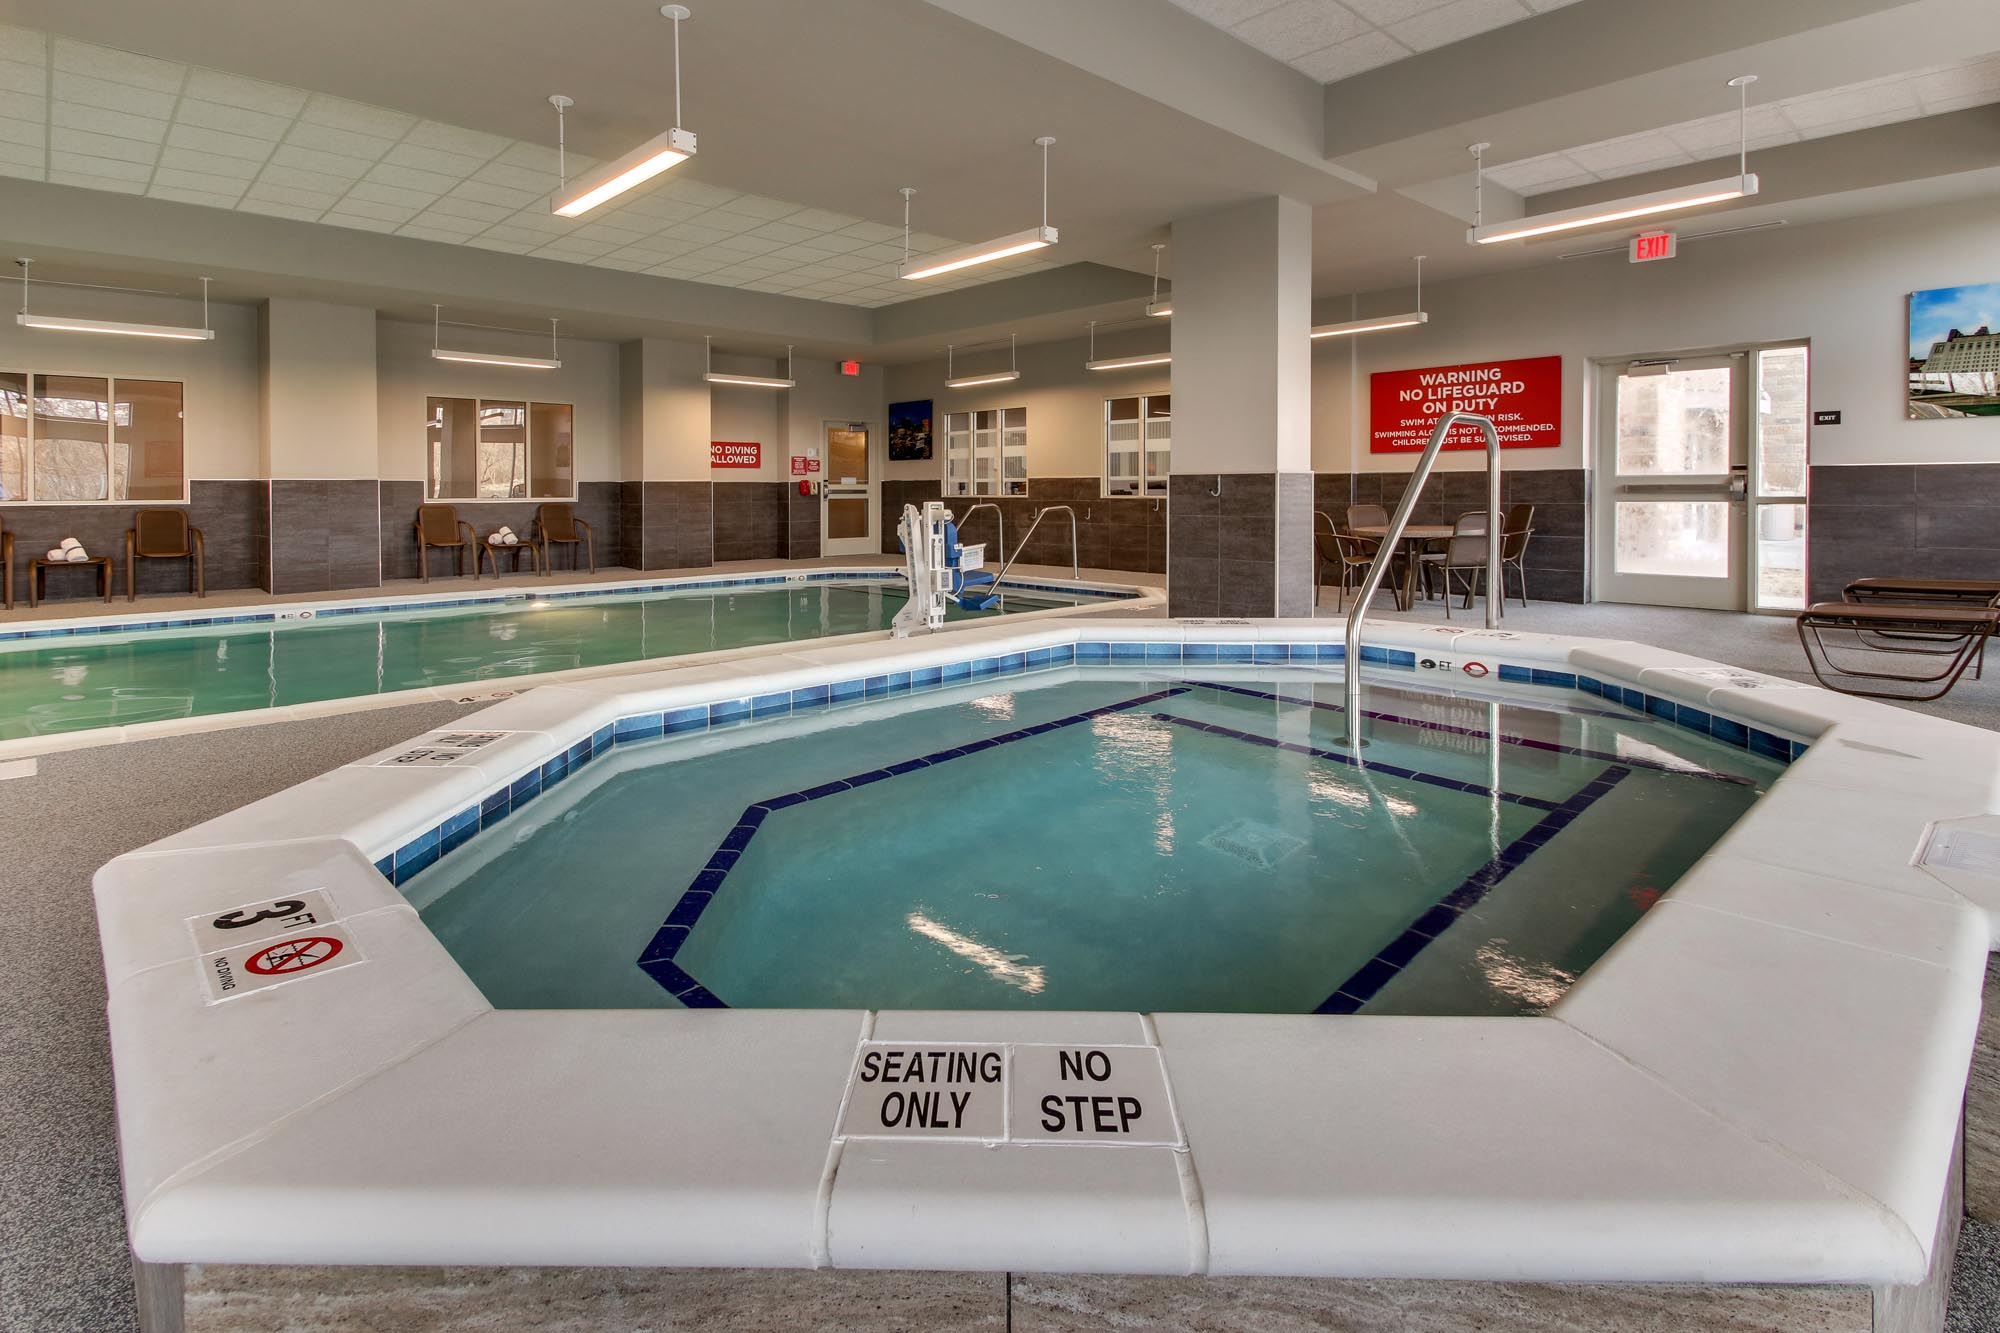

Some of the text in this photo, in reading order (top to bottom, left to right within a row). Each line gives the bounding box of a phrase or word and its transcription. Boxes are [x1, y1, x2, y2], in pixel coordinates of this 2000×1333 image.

[1637, 233, 1670, 260] EXIT
[1419, 368, 1502, 386] WARNING
[1399, 381, 1525, 402] NO LIFEGUARD
[1422, 397, 1499, 414] ON DUTY
[1400, 418, 1425, 427] SWIM
[1497, 412, 1524, 421] RISK.
[1374, 430, 1416, 439] SWIMMING
[1443, 436, 1458, 444] UST
[1460, 436, 1472, 444] BE
[1473, 433, 1533, 443] SURVISED.
[710, 455, 757, 464] ALLOWED
[725, 446, 758, 455] DIVING
[213, 900, 306, 930] 3
[280, 912, 317, 929] FT
[214, 956, 236, 991] NO DIVING
[860, 1051, 1002, 1083] SEATING
[1059, 1050, 1112, 1081] NO
[880, 1091, 972, 1129] ONLY
[1040, 1094, 1143, 1133] STEP
